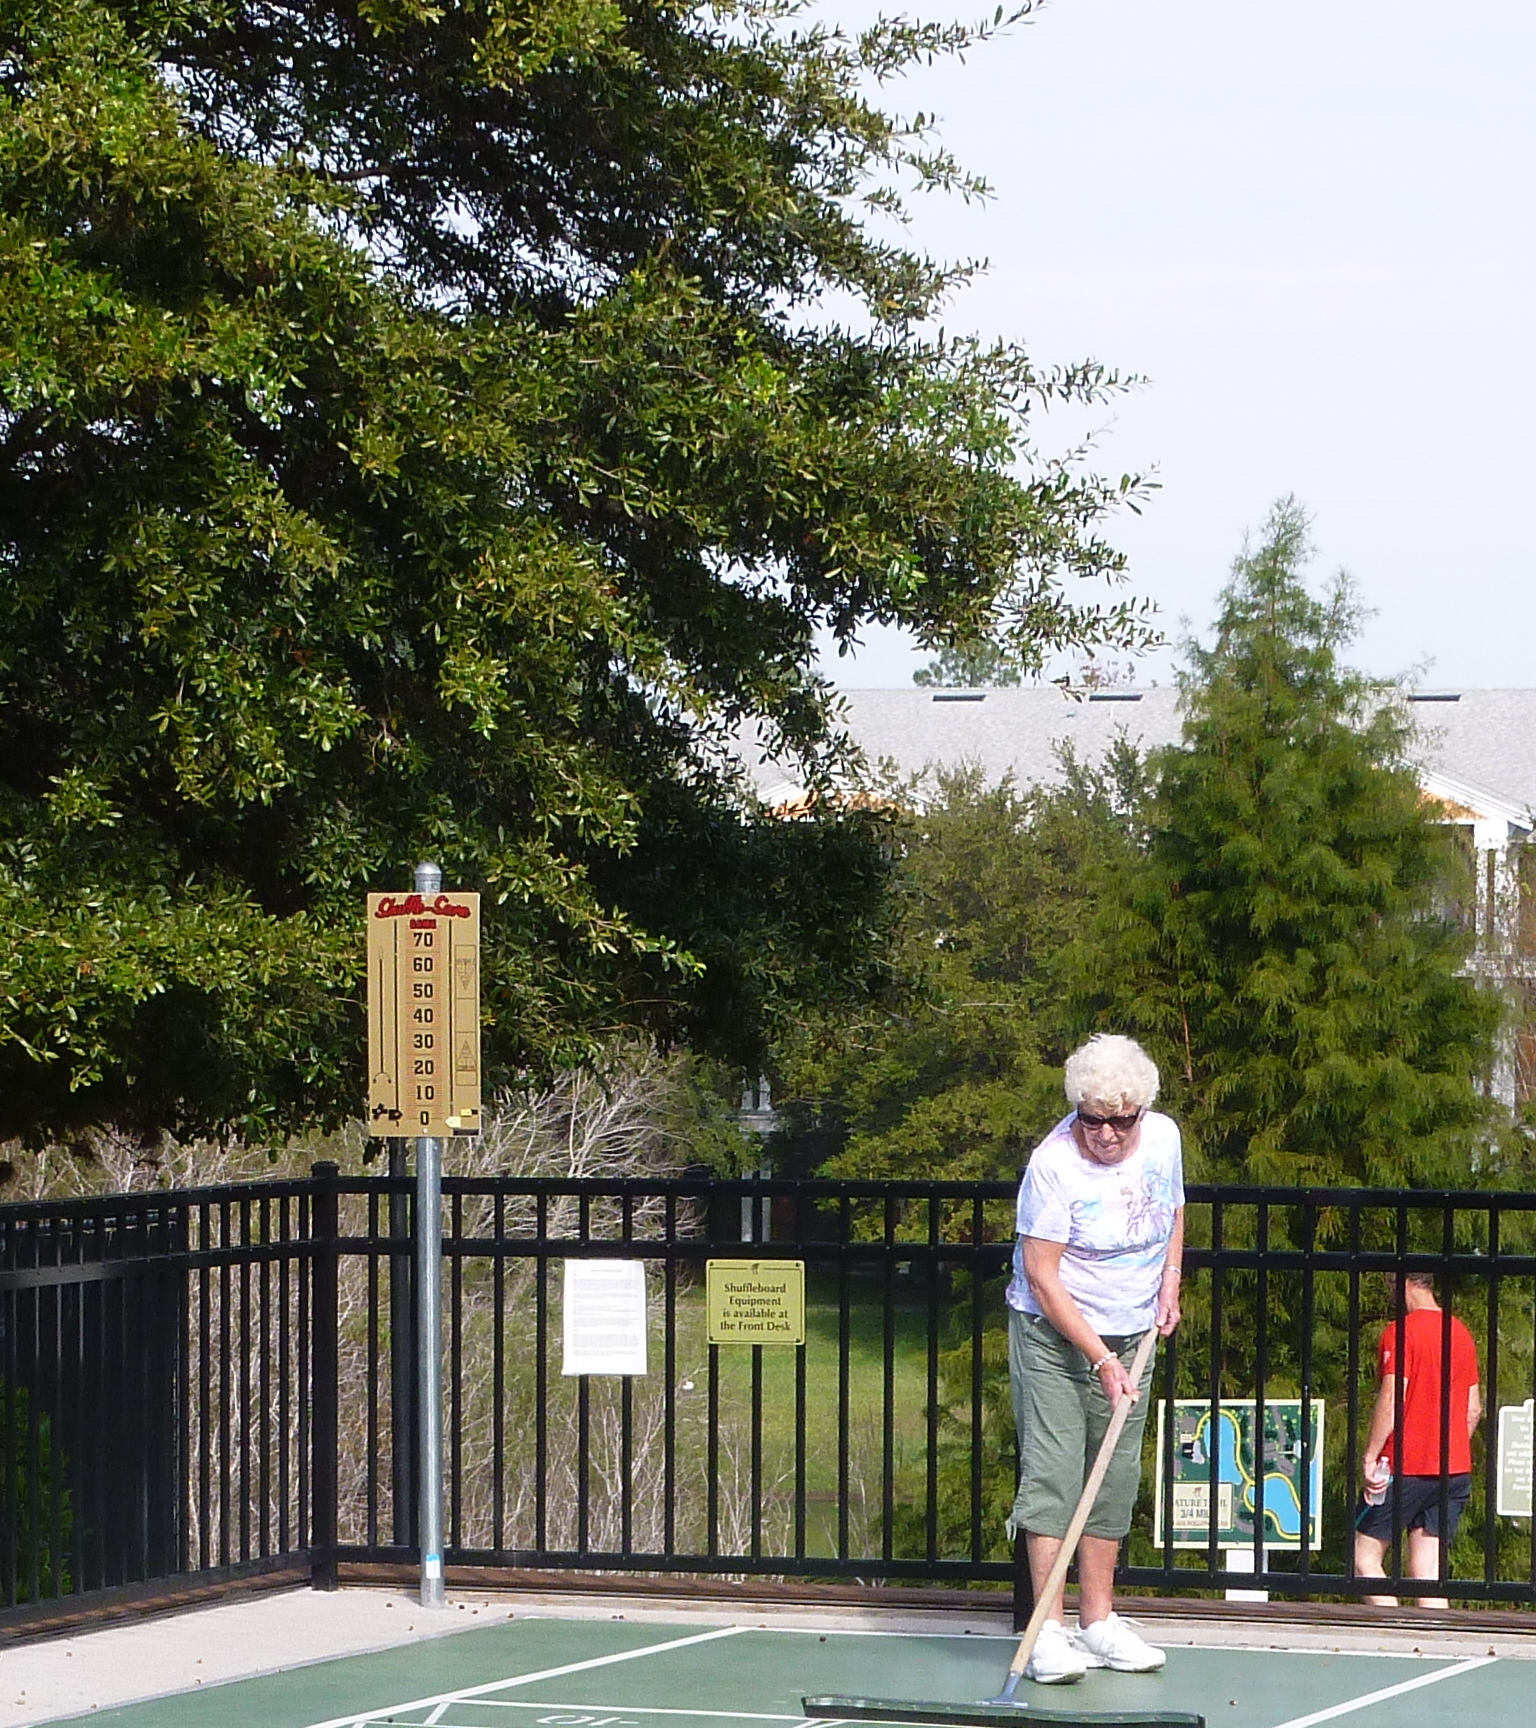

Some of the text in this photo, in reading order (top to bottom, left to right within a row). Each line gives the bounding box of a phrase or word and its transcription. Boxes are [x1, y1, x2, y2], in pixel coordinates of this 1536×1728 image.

[413, 932, 434, 947] 70
[413, 957, 434, 972] 60
[413, 983, 434, 998] 50
[413, 1009, 434, 1024] 40
[413, 1034, 434, 1049] 30
[413, 1060, 435, 1075] 20
[416, 1086, 434, 1100] 10
[420, 1111, 429, 1126] 0
[724, 1282, 786, 1293] Shuffleboard
[729, 1296, 781, 1307] Equipment
[723, 1308, 788, 1318] is available at
[720, 1320, 791, 1332] the Front Desk
[1175, 1499, 1228, 1508] ATURE TIL
